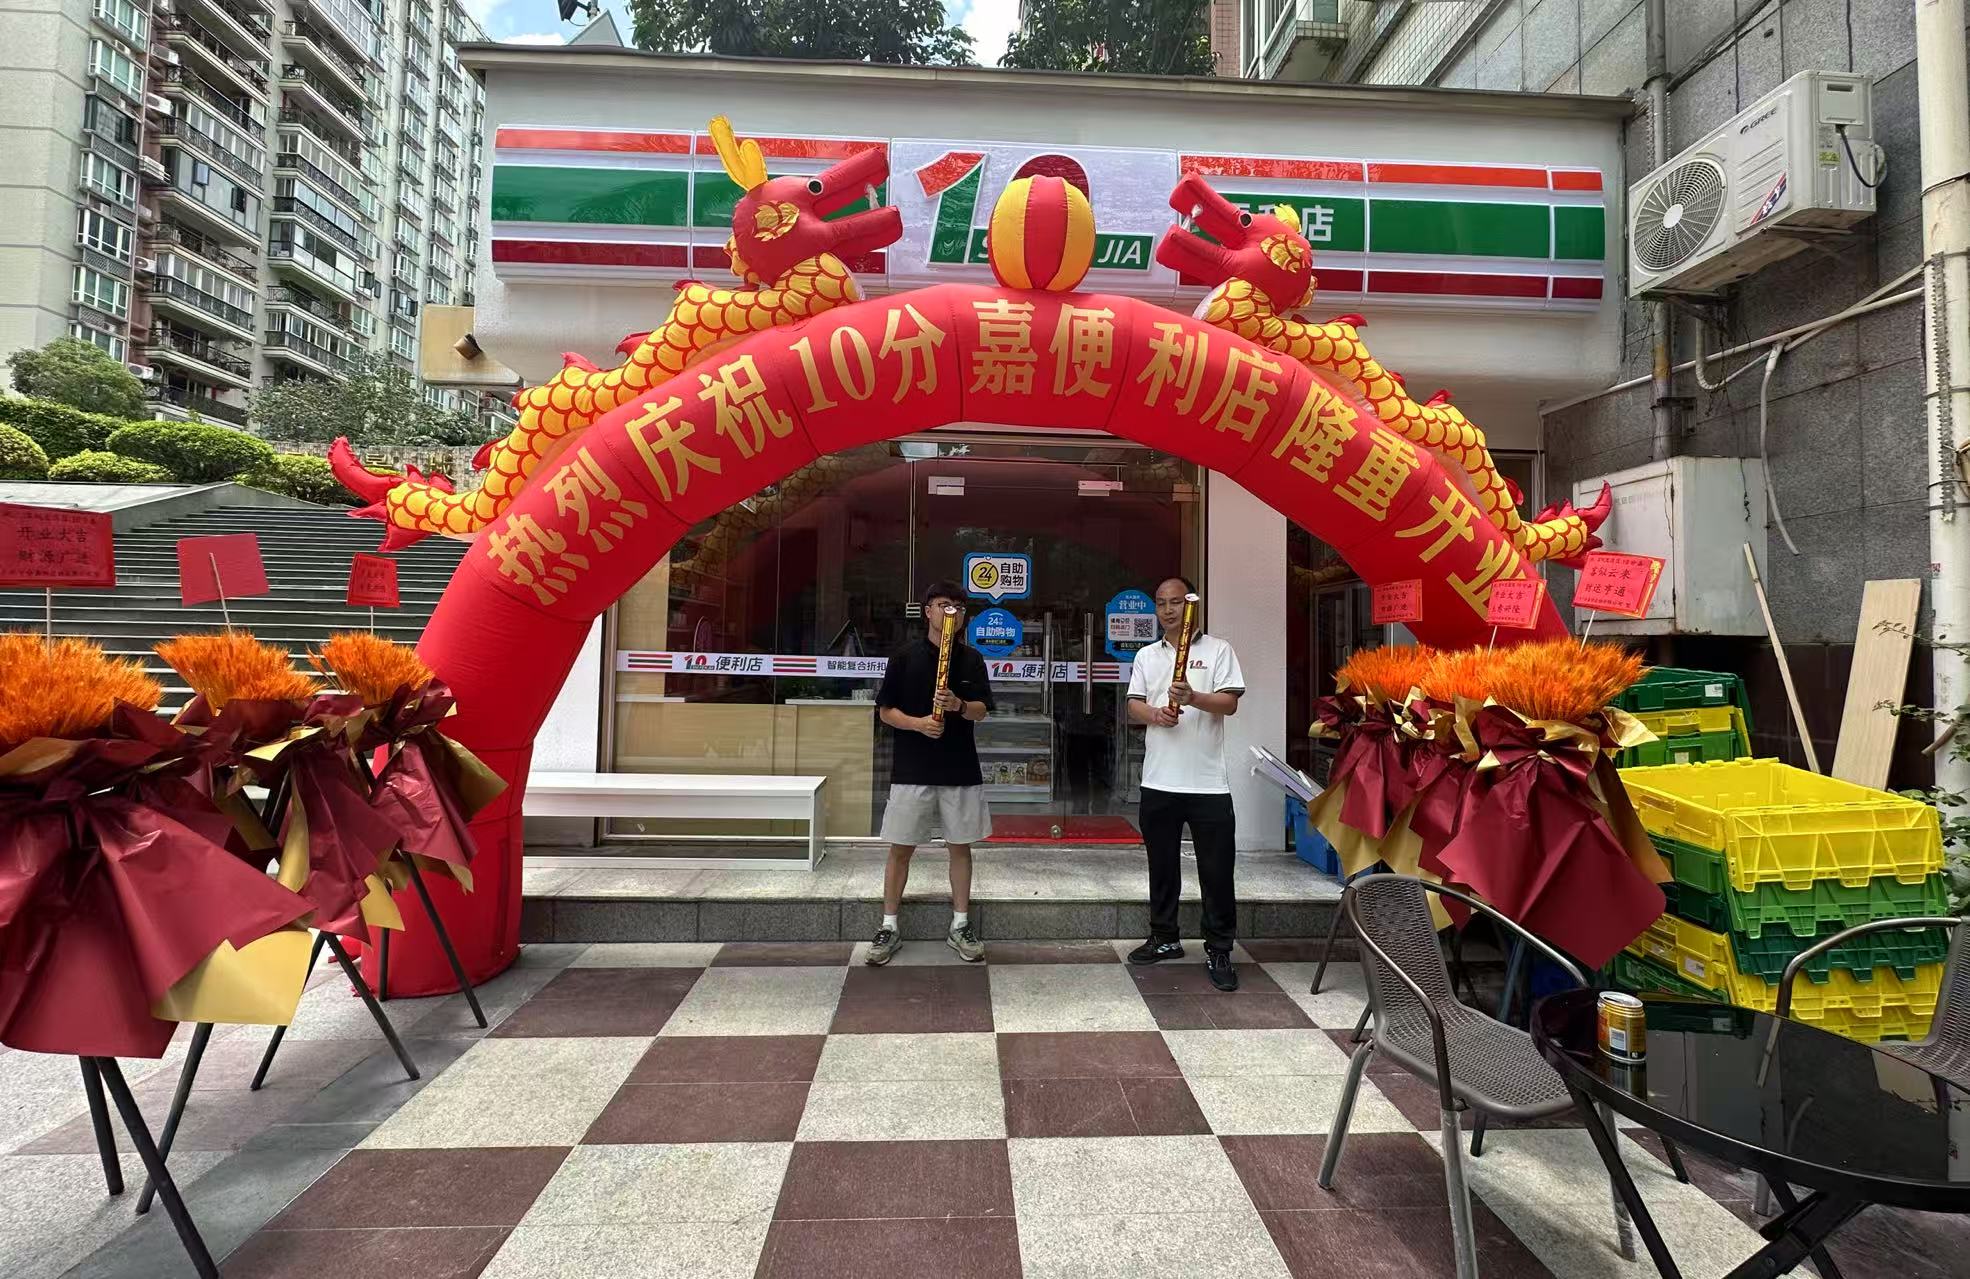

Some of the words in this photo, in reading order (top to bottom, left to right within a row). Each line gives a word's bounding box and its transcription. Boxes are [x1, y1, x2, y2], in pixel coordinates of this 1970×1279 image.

[1750, 107, 1777, 129] GREE
[1097, 239, 1142, 266] JIA
[1000, 562, 1024, 574] 自助
[1000, 574, 1024, 587] 购物
[1118, 600, 1147, 610] 营业中
[975, 626, 1016, 638] 自助购物
[715, 655, 763, 672] 便利店
